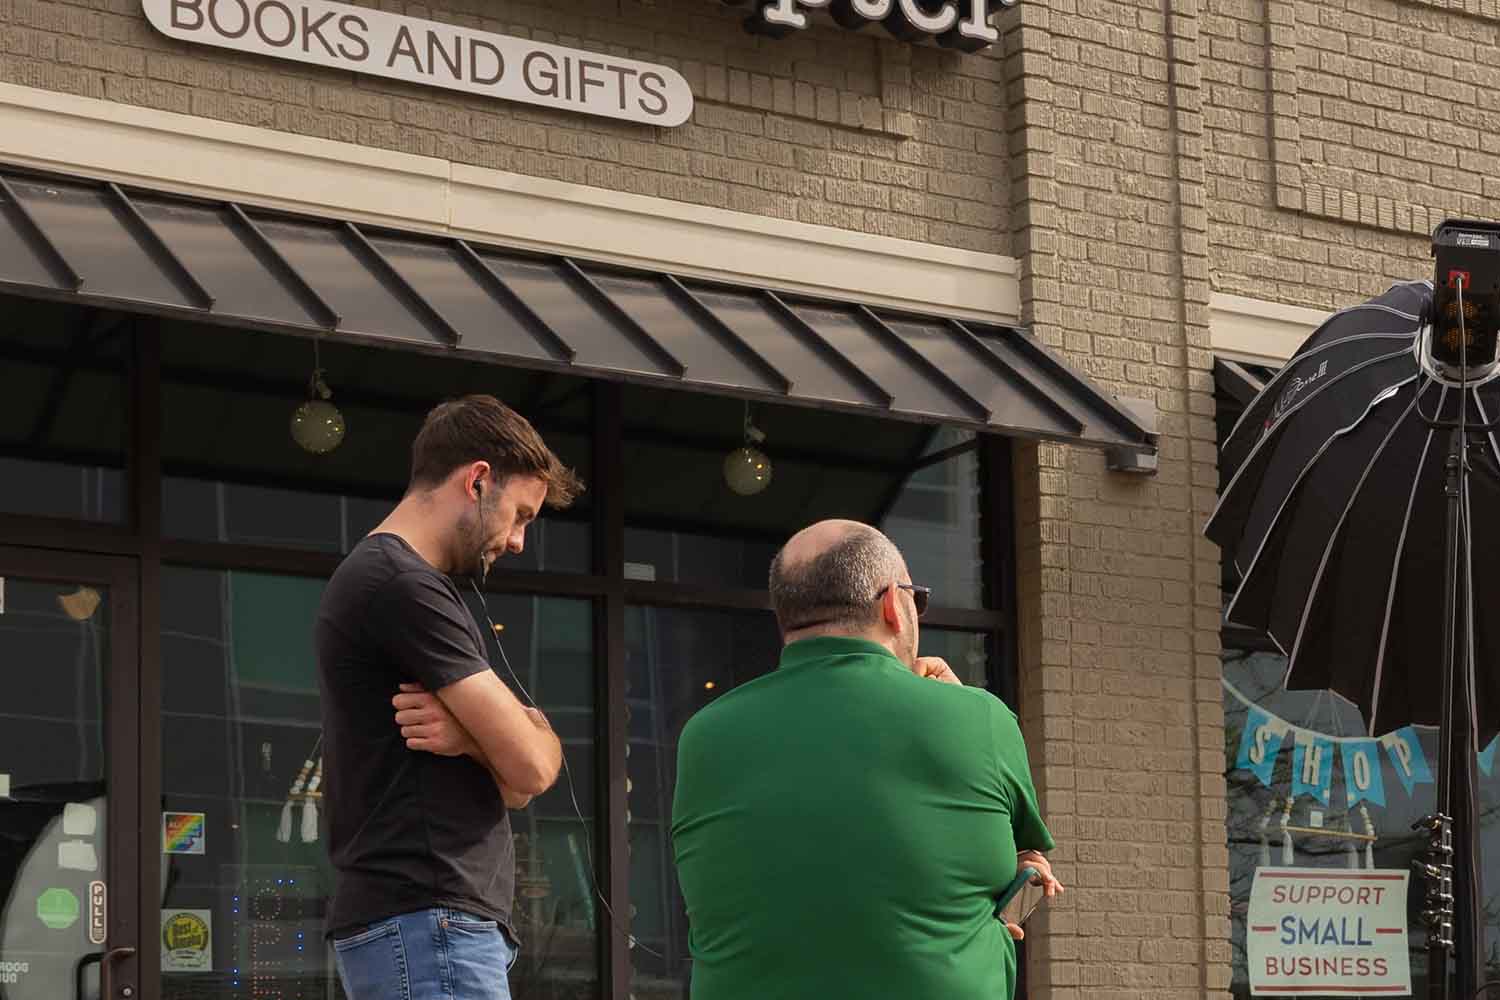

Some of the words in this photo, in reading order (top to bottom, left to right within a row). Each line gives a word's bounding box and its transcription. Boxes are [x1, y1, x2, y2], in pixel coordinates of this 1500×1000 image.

[171, 0, 370, 61] BOOKS
[386, 25, 505, 85] AND
[523, 51, 668, 116] GIFTS
[1250, 725, 1412, 790] SHOP
[93, 885, 104, 928] PULL
[1272, 885, 1385, 905] SUPPORT
[1280, 916, 1372, 946] SMALL
[1265, 957, 1388, 977] BUSINESS
